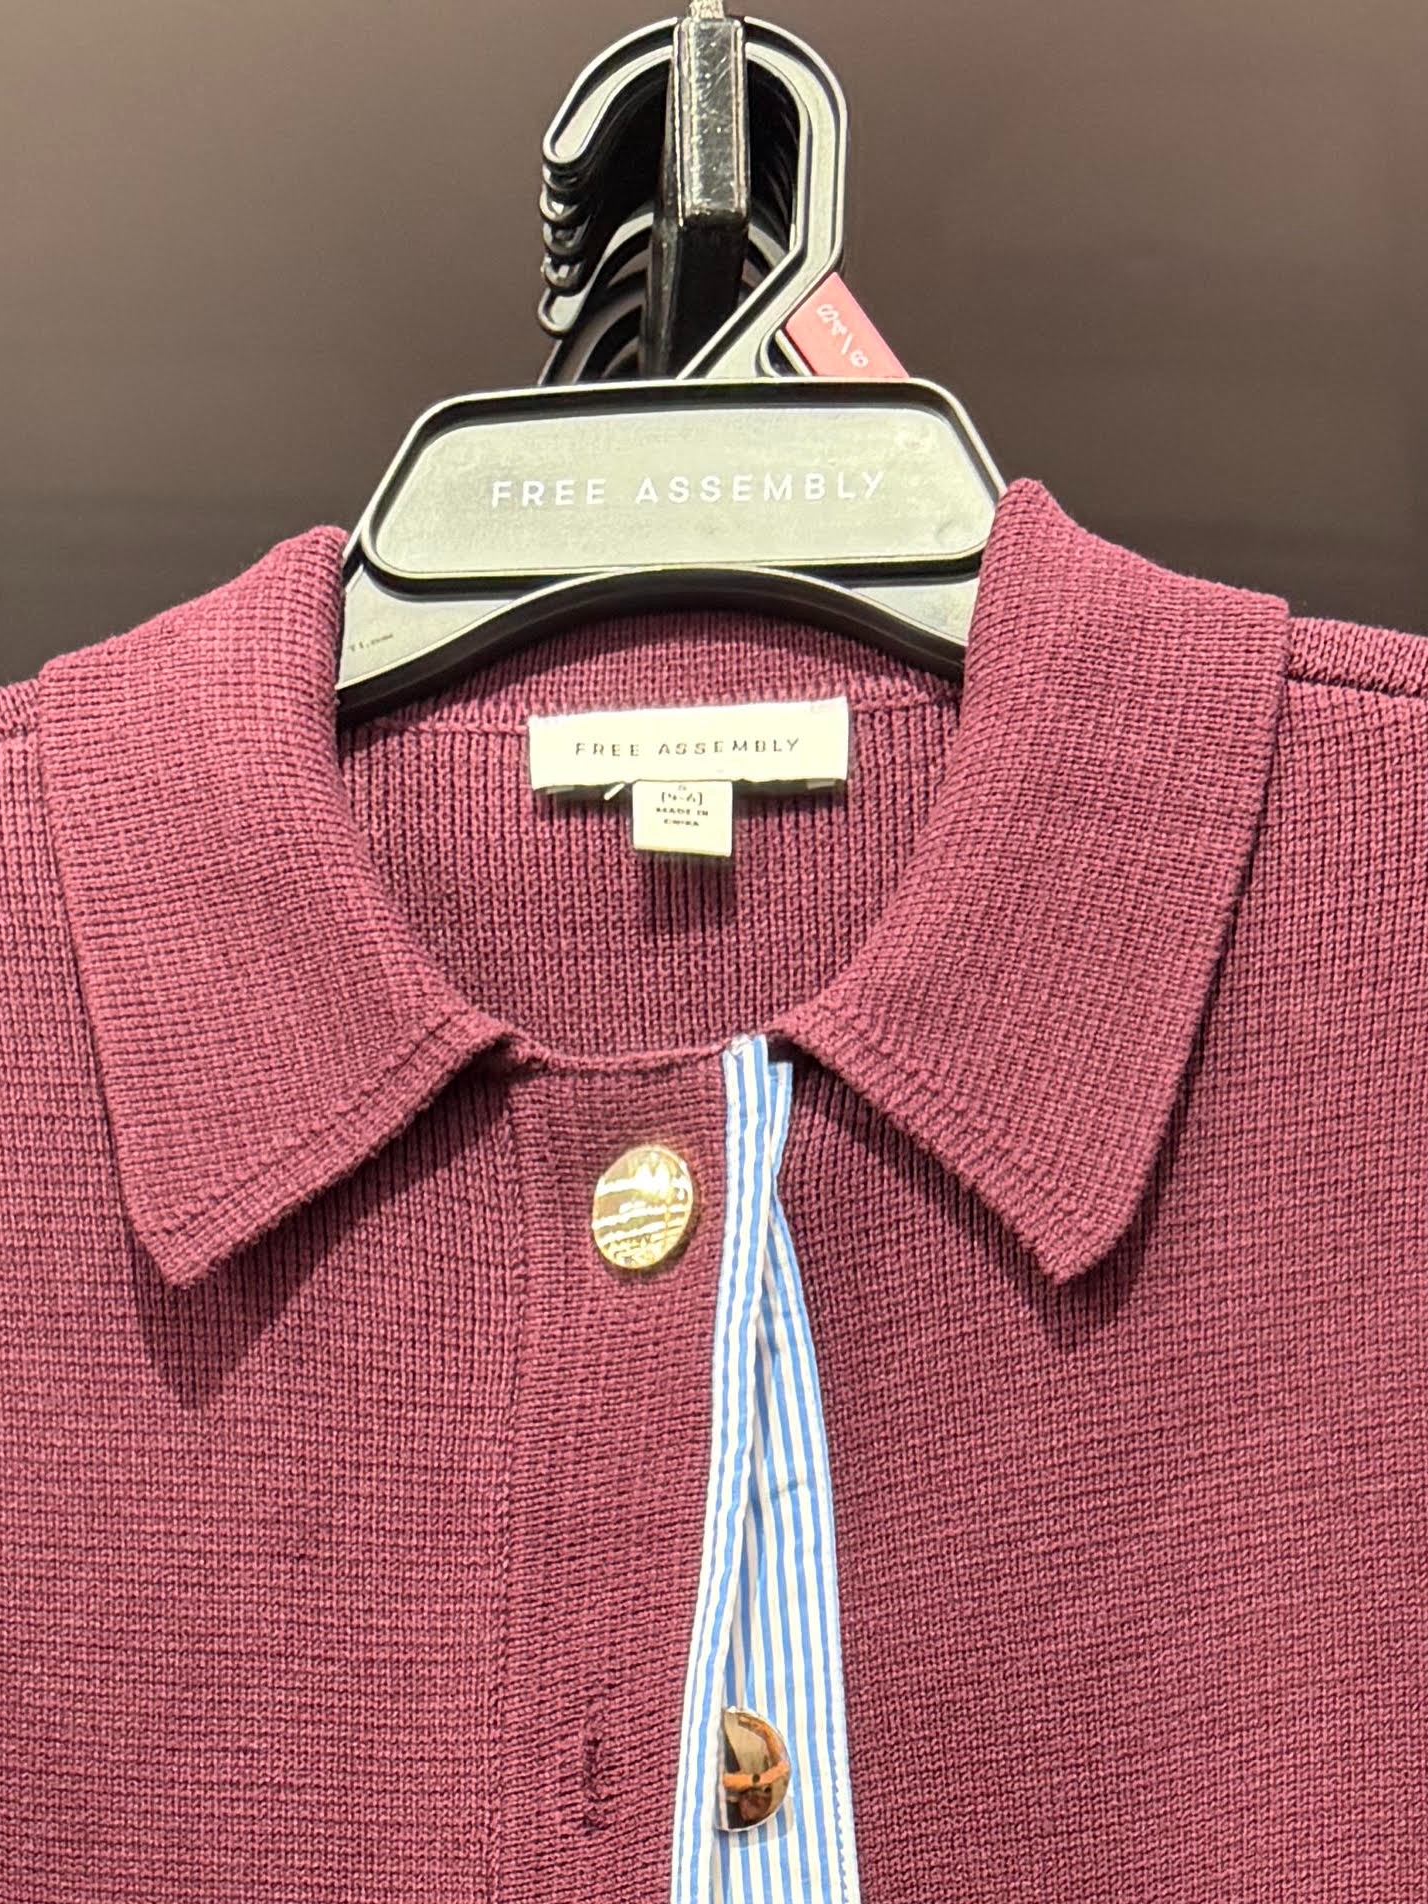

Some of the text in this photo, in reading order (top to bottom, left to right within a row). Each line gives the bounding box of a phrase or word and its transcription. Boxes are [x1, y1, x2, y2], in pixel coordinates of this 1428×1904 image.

[490, 470, 885, 508] FREE ASSEMBLY
[575, 737, 800, 757] FREE ASSEMBLY
